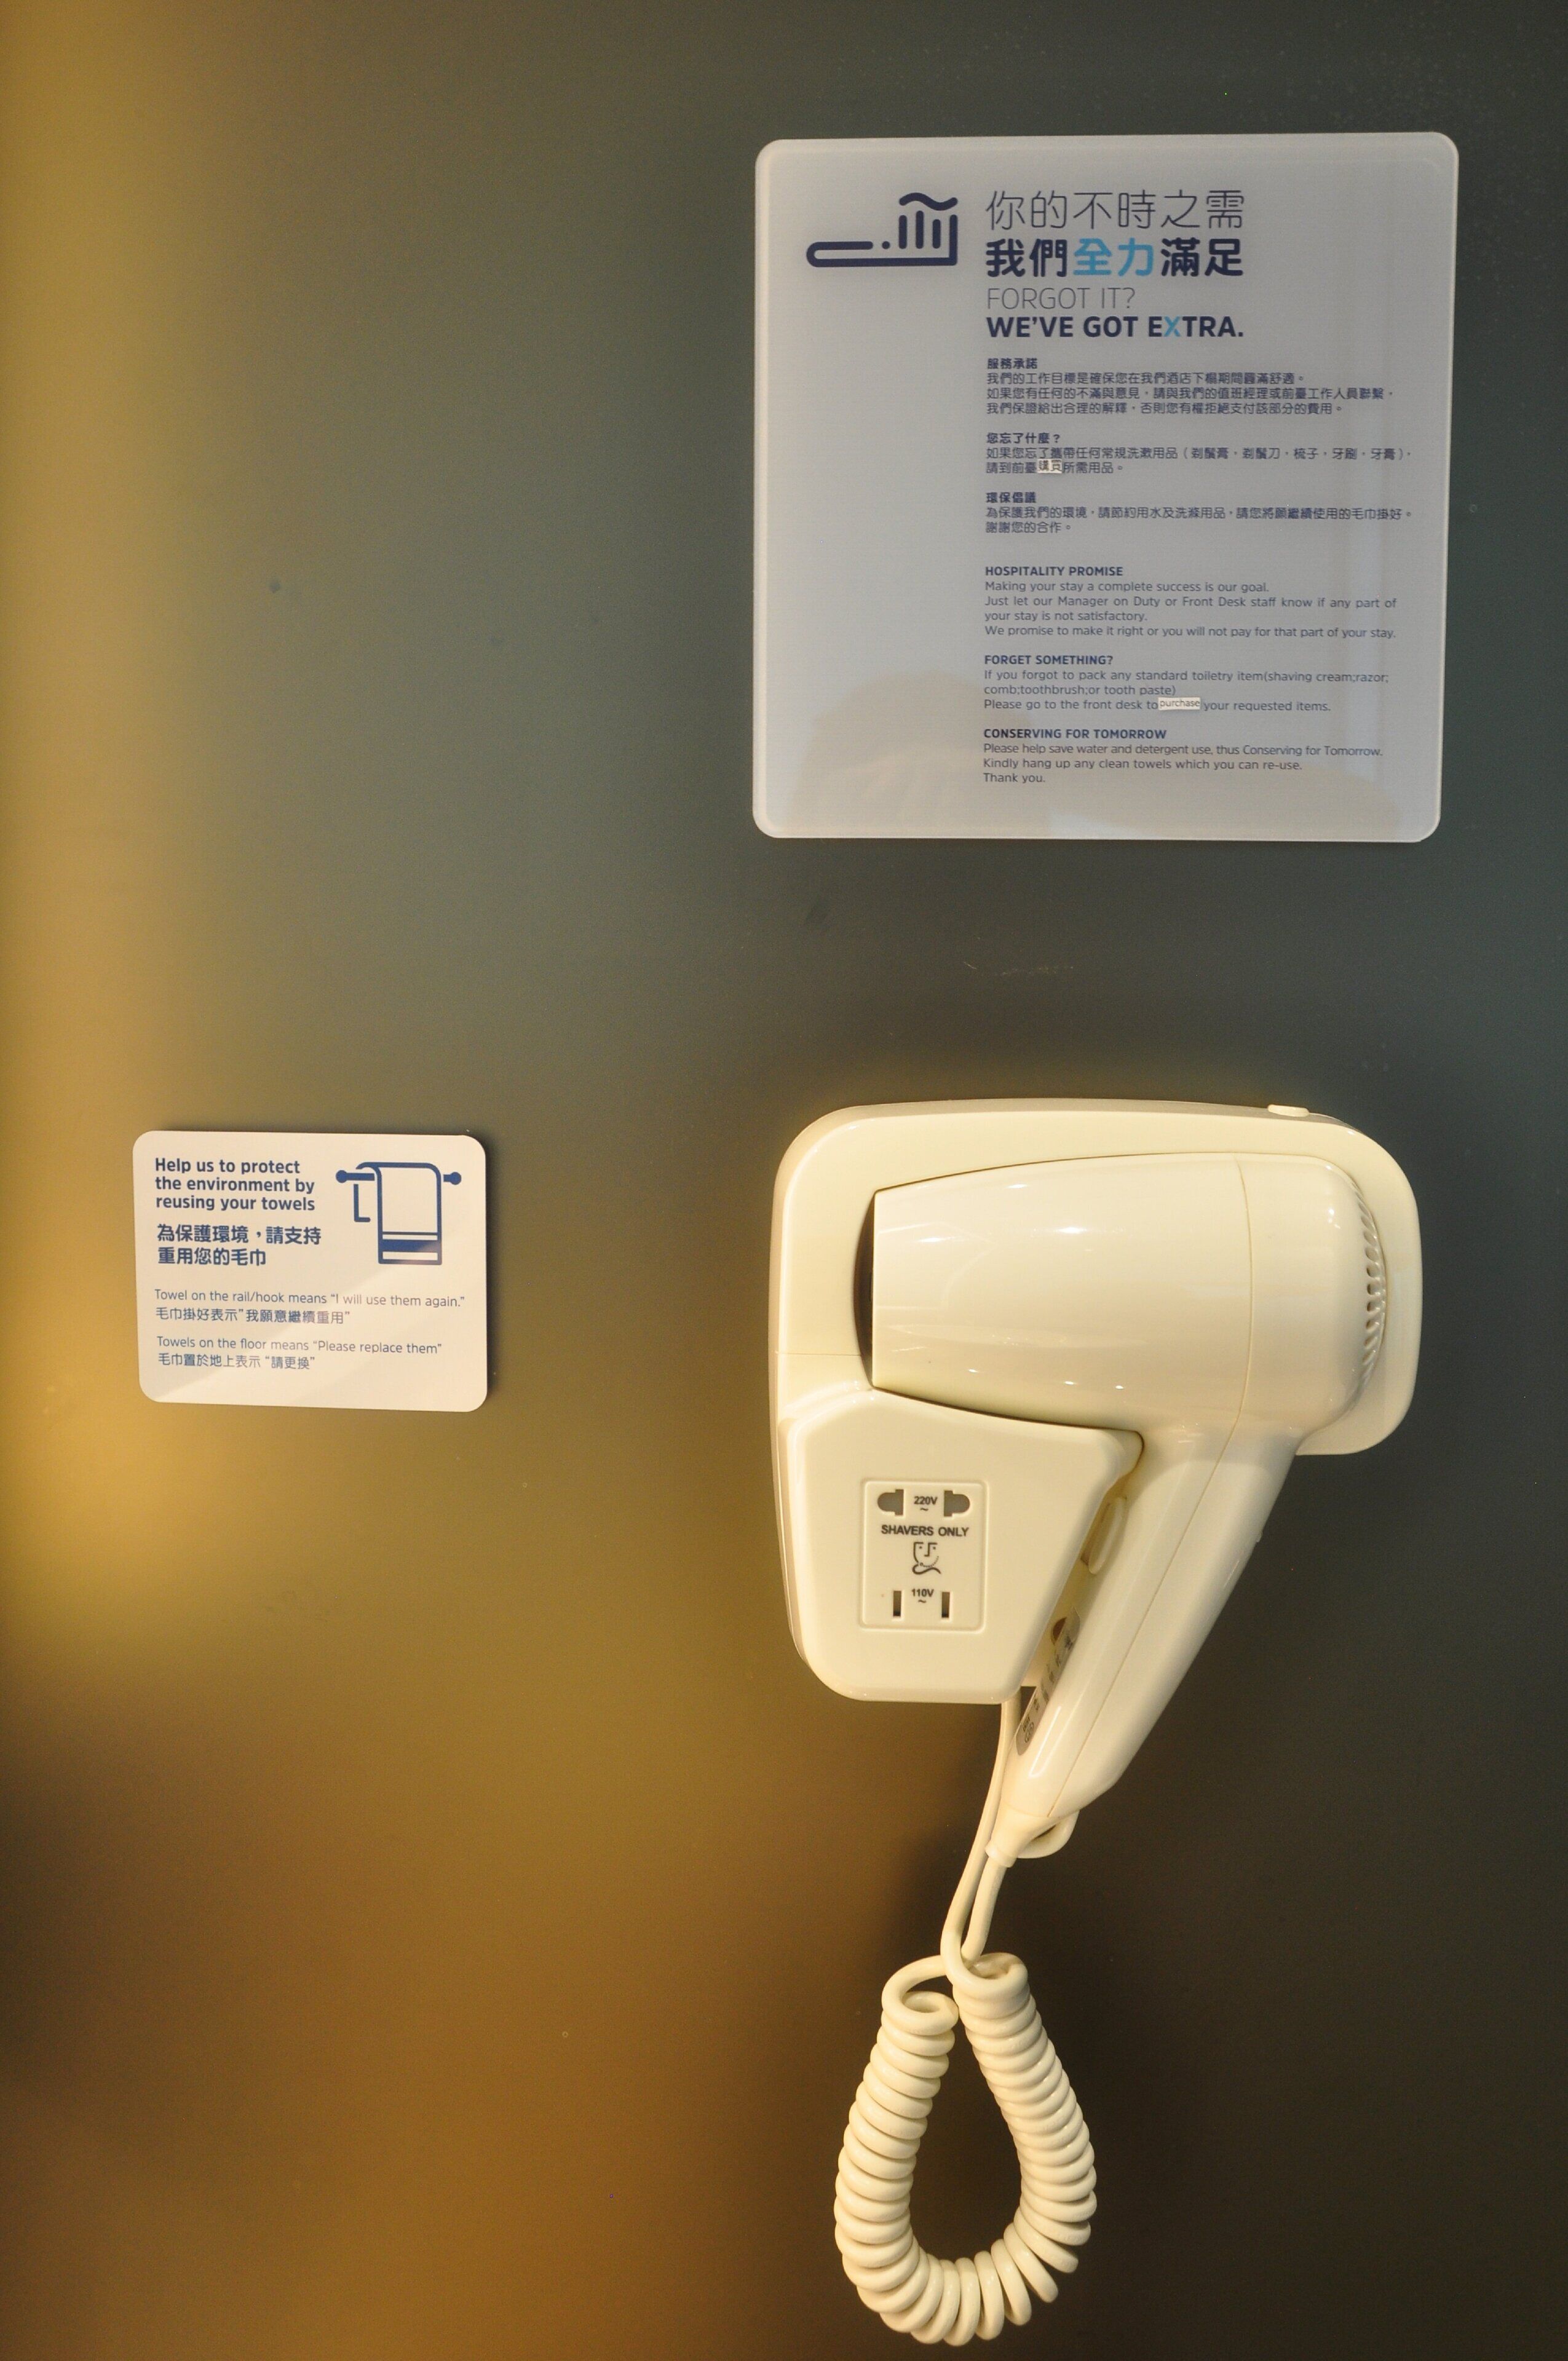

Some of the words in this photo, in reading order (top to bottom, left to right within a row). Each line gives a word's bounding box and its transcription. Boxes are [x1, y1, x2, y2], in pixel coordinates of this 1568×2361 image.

[985, 189, 1245, 230] 你的不時之需
[986, 237, 1244, 277] 我們全力滿足
[988, 288, 1090, 309] FORGOT
[1102, 287, 1135, 308] IT?
[1083, 316, 1138, 338] GOT
[1149, 316, 1243, 337] EXTRA.
[987, 358, 1037, 369] 服務承諾
[986, 432, 1060, 444] 您忘了什麼？
[986, 492, 1036, 503] 環保倡議
[986, 521, 1071, 533] 謝謝您的合作。
[985, 566, 1065, 575] HOSPITALITY
[1069, 566, 1123, 576] PROMISE
[985, 582, 1026, 592] Making
[1060, 582, 1083, 592] stay
[1098, 582, 1152, 592] complete
[1205, 582, 1214, 591] is
[1241, 582, 1269, 593] goal.
[985, 596, 1008, 606] Just
[1014, 596, 1028, 606] let
[1058, 596, 1108, 607] Manager
[1134, 596, 1160, 607] Duty
[1182, 596, 1213, 606] Front
[1219, 597, 1246, 606] Desk
[1251, 597, 1277, 607] staff
[1281, 598, 1312, 607] know
[1318, 598, 1325, 607] if
[1330, 600, 1351, 609] any
[1356, 599, 1380, 609] part
[1384, 598, 1397, 607] of
[985, 613, 1010, 622] your
[1015, 612, 1038, 622] stay
[1042, 611, 1050, 620] is
[1055, 612, 1074, 620] not
[1078, 611, 1147, 622] satisfactory.
[985, 626, 1004, 635] We
[1008, 626, 1053, 636] promise
[1057, 627, 1069, 635] to
[1072, 627, 1103, 635] make
[1107, 627, 1114, 635] it
[1117, 627, 1143, 637] right
[1162, 628, 1182, 637] you
[1186, 627, 1205, 636] will
[1208, 628, 1227, 636] not
[1230, 629, 1251, 638] pay
[1254, 627, 1271, 636] for
[1274, 628, 1297, 636] that
[1301, 628, 1323, 638] part
[1327, 627, 1339, 637] of
[1341, 630, 1367, 639] your
[1371, 629, 1395, 639] stay.
[984, 655, 1031, 665] FORGET
[1035, 655, 1113, 665] SOMETHING?
[985, 670, 992, 679] If
[1023, 670, 1058, 681] forgot
[1079, 671, 1106, 681] pack
[1136, 671, 1187, 680] standard
[1192, 671, 1233, 682] toiletry
[1238, 671, 1312, 682] item(shaving
[984, 685, 1099, 695] comb;toothbrush;or
[1104, 686, 1135, 694] tooth
[1140, 685, 1177, 697] paste)
[984, 699, 1021, 709] Please
[1026, 702, 1040, 710] go
[1045, 700, 1056, 709] to
[1061, 700, 1079, 709] the
[1083, 700, 1112, 709] front
[1116, 700, 1142, 709] desk
[1147, 701, 1158, 710] to
[1160, 700, 1200, 708] purchase
[1203, 701, 1229, 711] your
[1233, 702, 1292, 711] requested
[1296, 702, 1331, 711] items.
[983, 729, 1061, 738] CONSERVING
[1066, 729, 1089, 738] FOR
[1093, 729, 1166, 739] TOMORROW
[984, 743, 1019, 753] Please
[1023, 744, 1045, 754] help
[1111, 745, 1131, 753] and
[1136, 745, 1189, 755] detergent
[1216, 745, 1240, 754] thus
[1243, 745, 1302, 756] Conserving
[1305, 746, 1321, 755] for
[1324, 746, 1383, 756] Tomorrow.
[984, 758, 1018, 769] Kindly
[1023, 759, 1051, 769] hang
[1056, 761, 1071, 769] up
[1074, 761, 1095, 769] any
[1099, 759, 1129, 769] clean
[1133, 759, 1171, 769] towels
[1176, 759, 1210, 769] which
[1214, 762, 1234, 770] you
[983, 773, 1018, 782] Thank
[156, 1158, 191, 1173] Help
[197, 1161, 214, 1172] us
[219, 1160, 235, 1174] to
[241, 1160, 300, 1177] protect
[155, 1176, 181, 1190] the
[187, 1177, 290, 1192] environment
[296, 1178, 315, 1194] by
[156, 1195, 215, 1211] reusing
[220, 1199, 256, 1211] your
[261, 1197, 315, 1211] towels
[157, 1224, 321, 1244] 為保護環境，請支持
[158, 1247, 266, 1266] 重用您的毛巾
[154, 1289, 187, 1300] Towel
[210, 1291, 228, 1301] the
[233, 1291, 284, 1302] rail/hook
[289, 1295, 327, 1303] means
[343, 1294, 362, 1304] will
[366, 1297, 386, 1305] use
[390, 1295, 421, 1306] them
[157, 1336, 195, 1347] Towels
[218, 1338, 236, 1348] the
[240, 1338, 266, 1349] floor
[360, 1342, 403, 1353] replace
[914, 1496, 938, 1505] 220V
[881, 1524, 934, 1536] SHAVERS
[938, 1527, 969, 1537] ONLY
[911, 1588, 934, 1597] 110V
